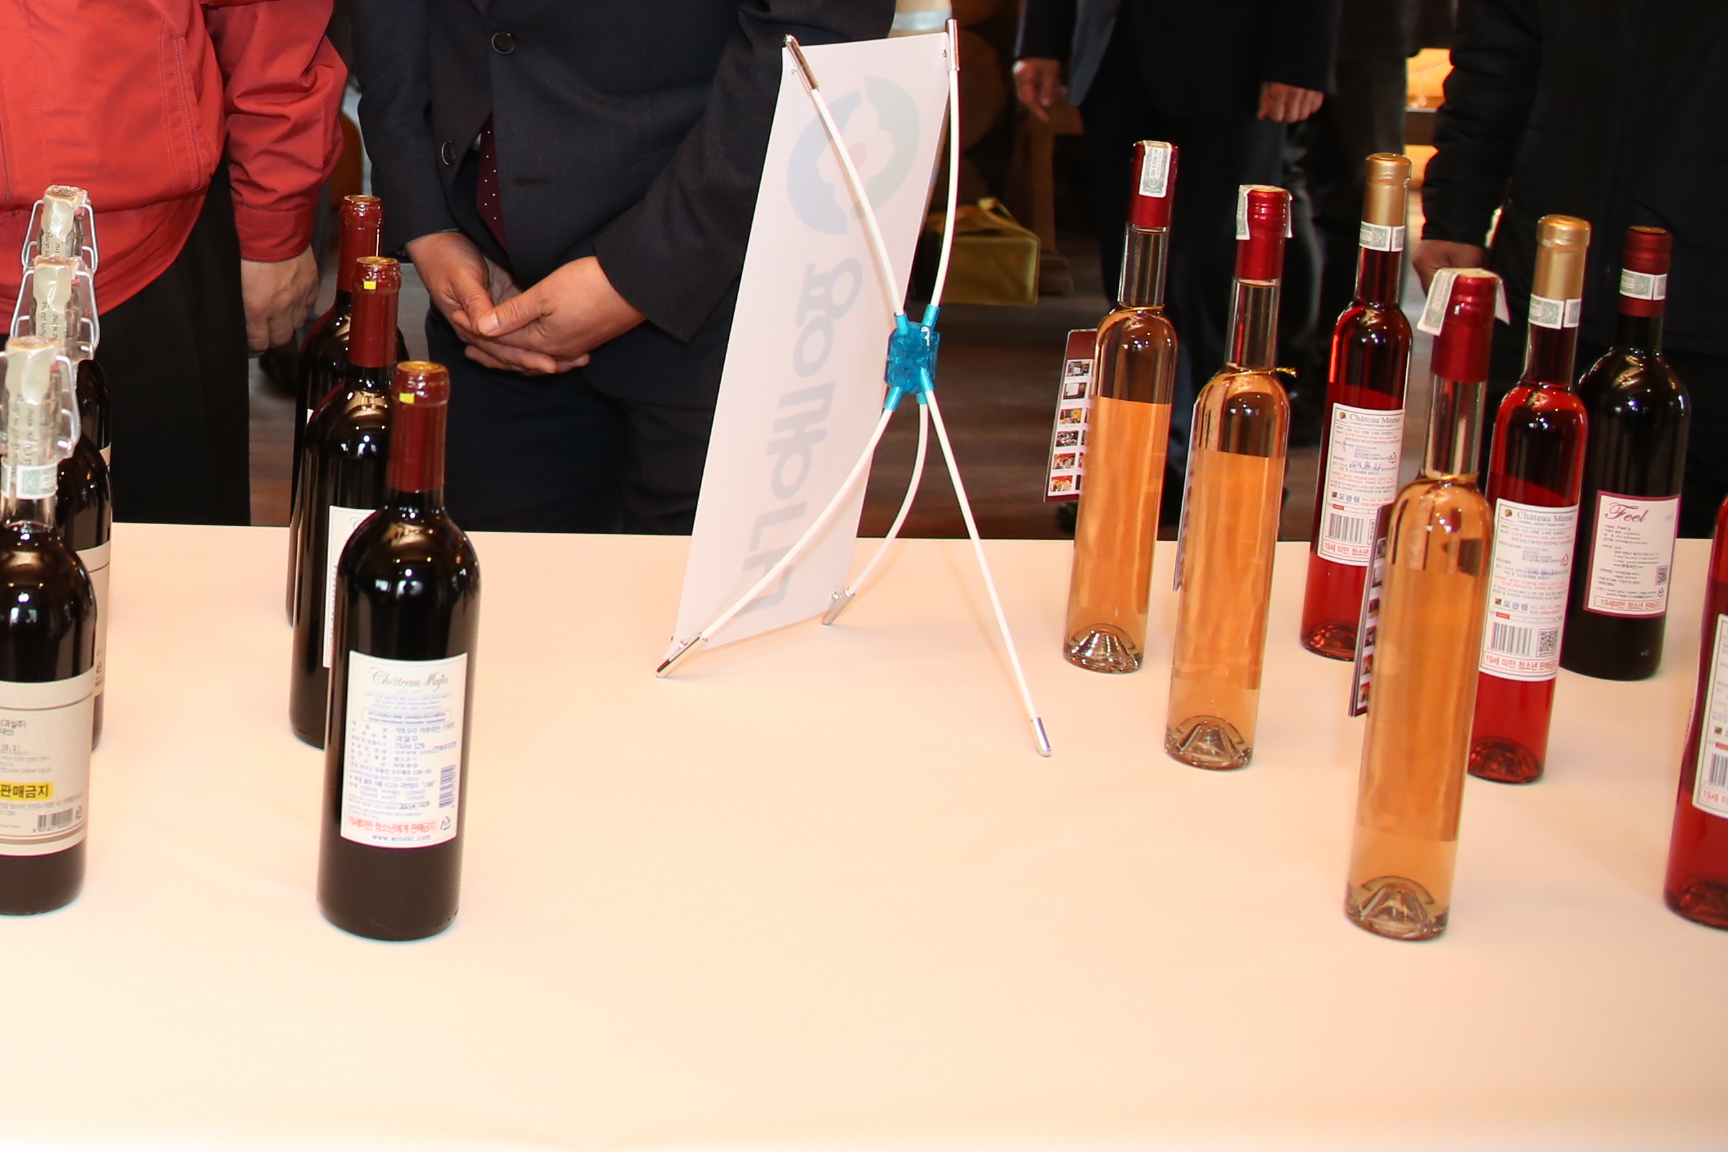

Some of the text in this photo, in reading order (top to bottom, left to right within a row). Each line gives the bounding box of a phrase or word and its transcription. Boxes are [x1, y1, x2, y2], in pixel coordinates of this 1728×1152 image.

[1349, 413, 1380, 423] Château
[1517, 511, 1551, 522] Château
[1604, 501, 1650, 523] Feel
[1324, 542, 1369, 558] 19세 미만 청소년
[1485, 655, 1500, 666] 19세
[1501, 657, 1516, 669] 미만
[1518, 658, 1538, 672] 청소년
[0, 783, 49, 798] 판매금지
[1702, 790, 1719, 802] 19세
[375, 821, 408, 834] 청소년에게
[411, 821, 436, 833] 판매금지
